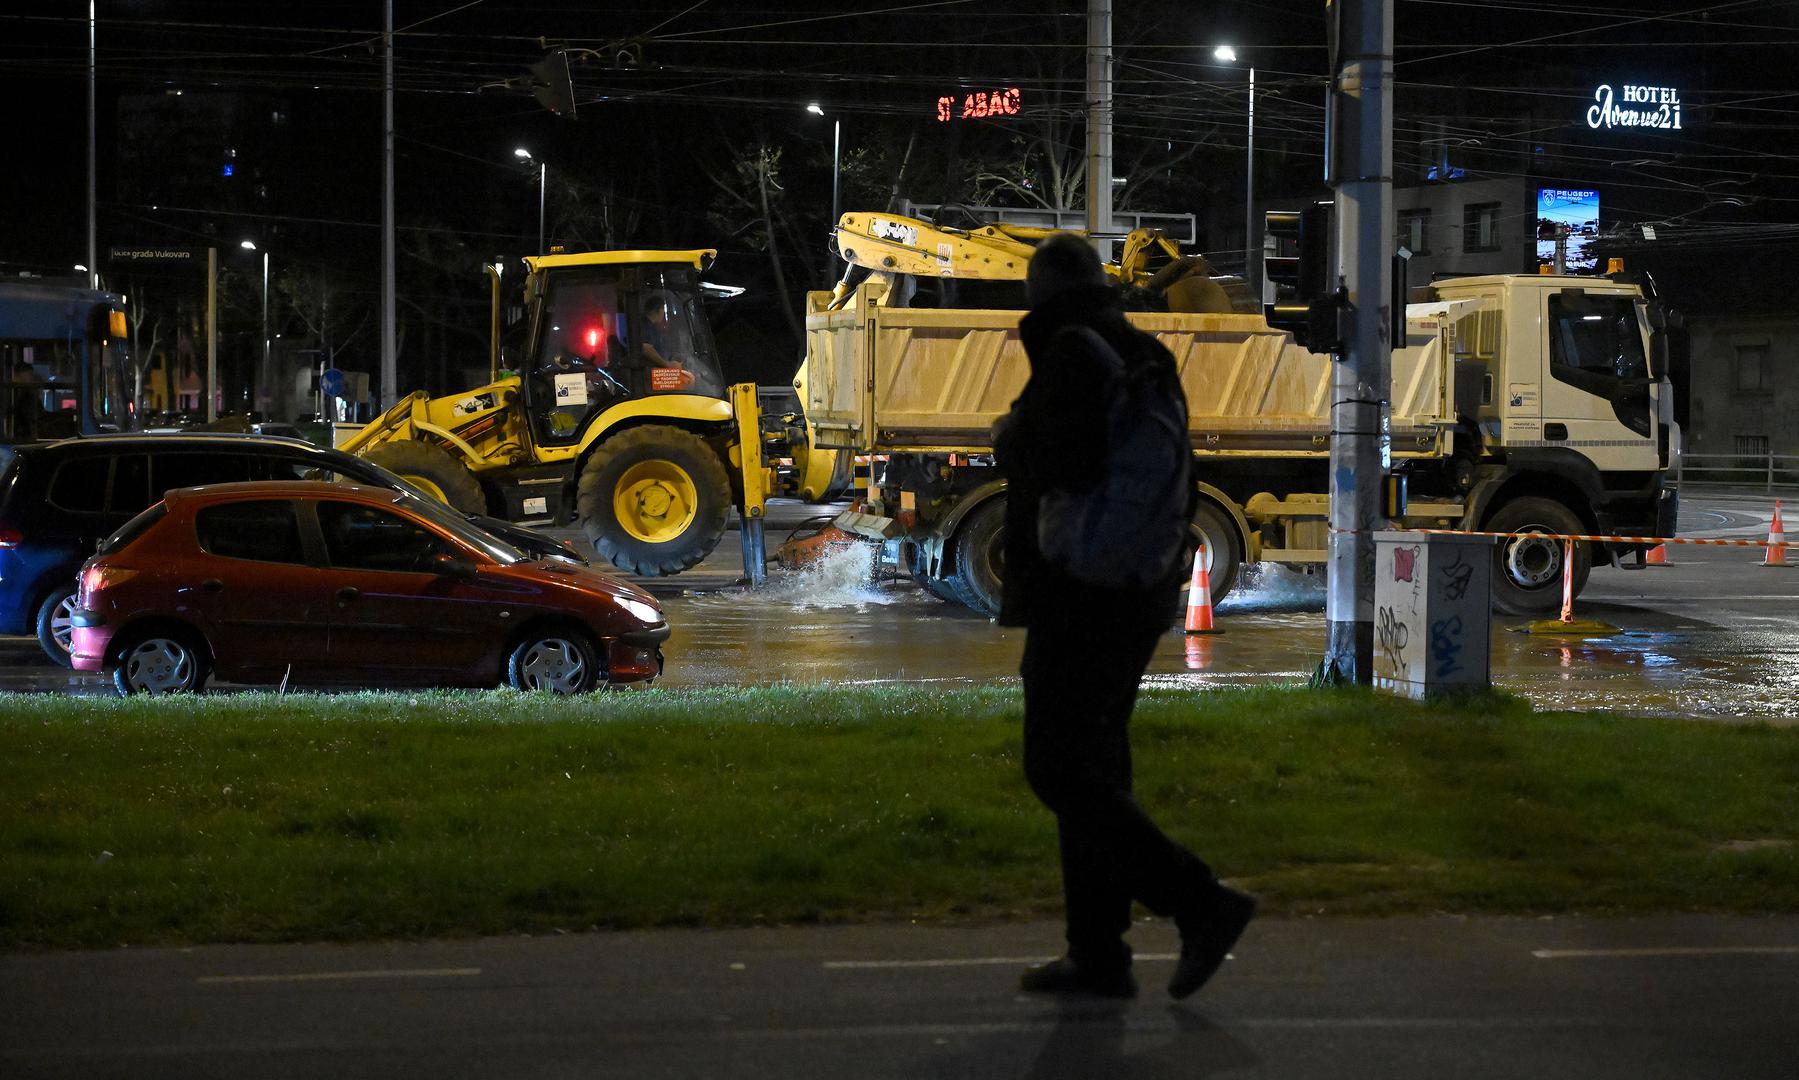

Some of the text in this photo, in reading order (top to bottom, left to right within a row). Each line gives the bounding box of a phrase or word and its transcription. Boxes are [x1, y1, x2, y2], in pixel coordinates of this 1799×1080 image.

[1623, 85, 1680, 104] HOTEL
[132, 250, 154, 259] grada
[155, 250, 190, 258] Vukovara
